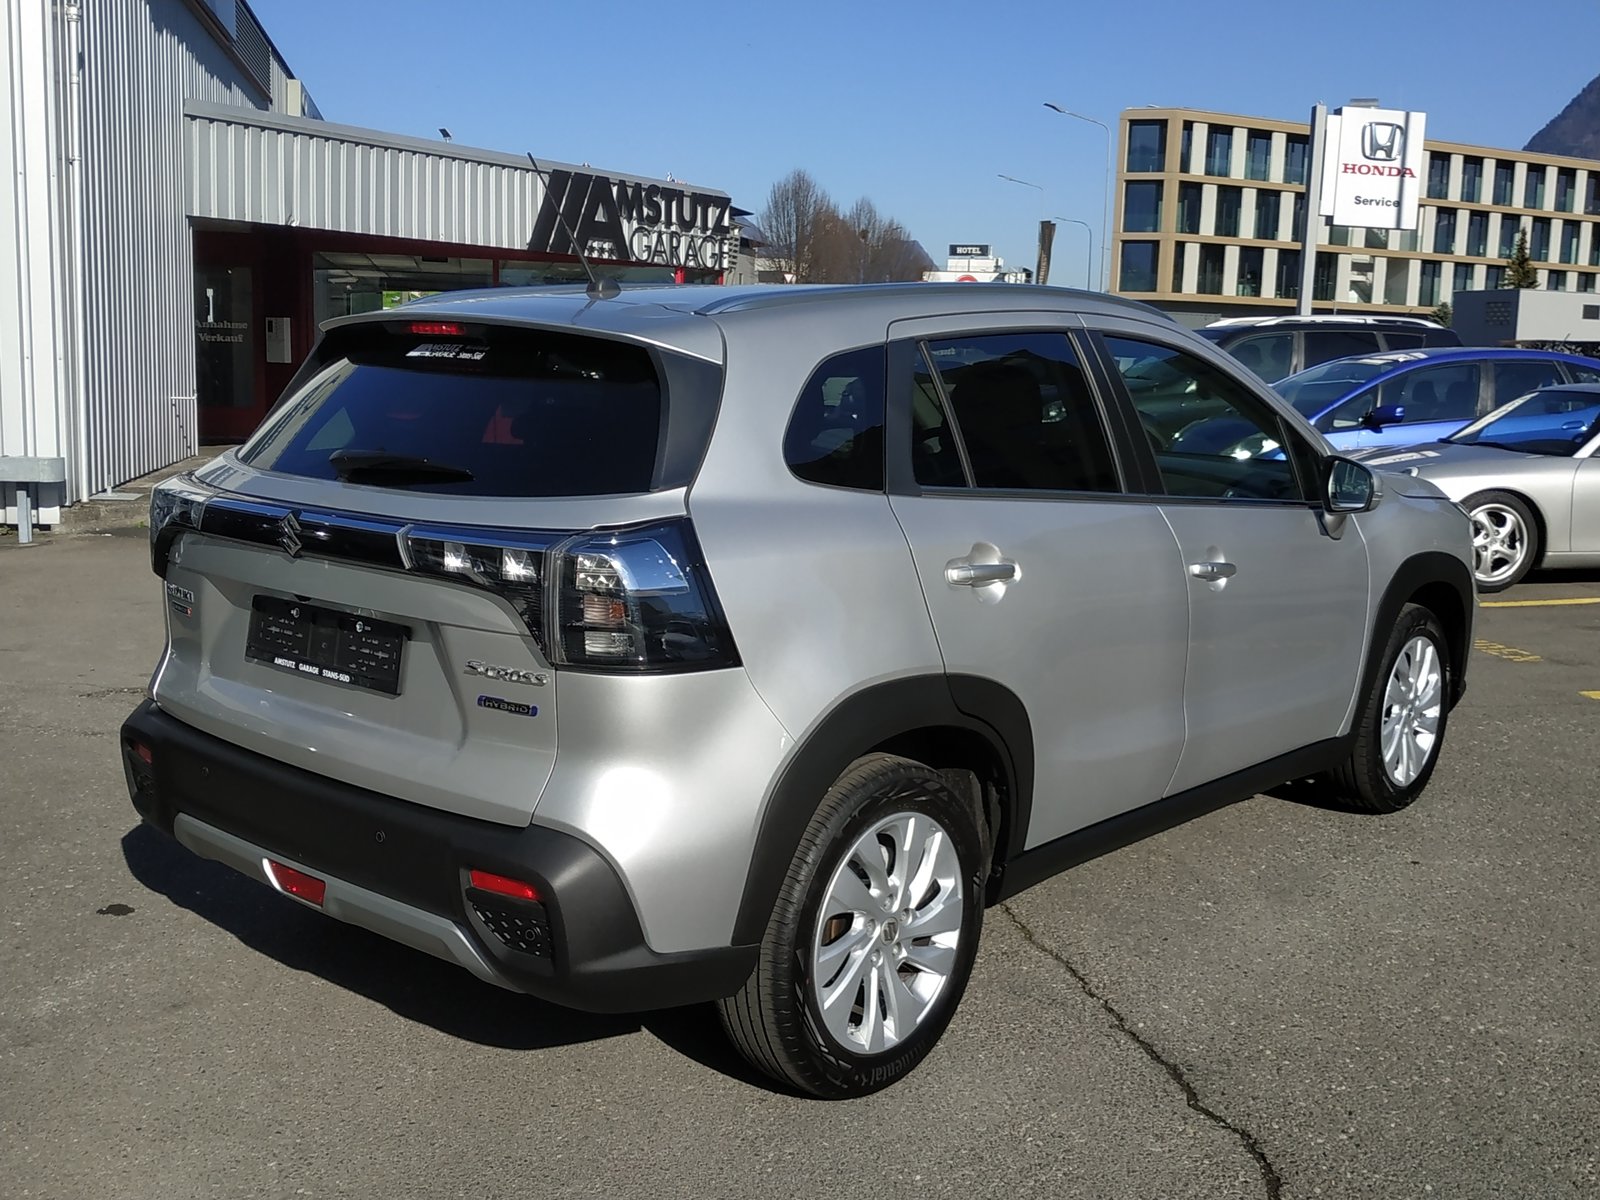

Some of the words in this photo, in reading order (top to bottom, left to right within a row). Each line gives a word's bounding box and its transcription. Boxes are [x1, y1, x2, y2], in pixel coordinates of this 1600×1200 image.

[1342, 163, 1417, 178] HONDA
[1354, 195, 1400, 208] Service
[566, 173, 732, 260] AMSTUTZ
[629, 226, 731, 271] GARAGE
[956, 246, 982, 255] HOTEL
[198, 333, 244, 343] Verkauf
[274, 657, 296, 669] AMSTUTZ
[299, 663, 320, 675] GARAGE
[485, 700, 528, 714] HYBRID
